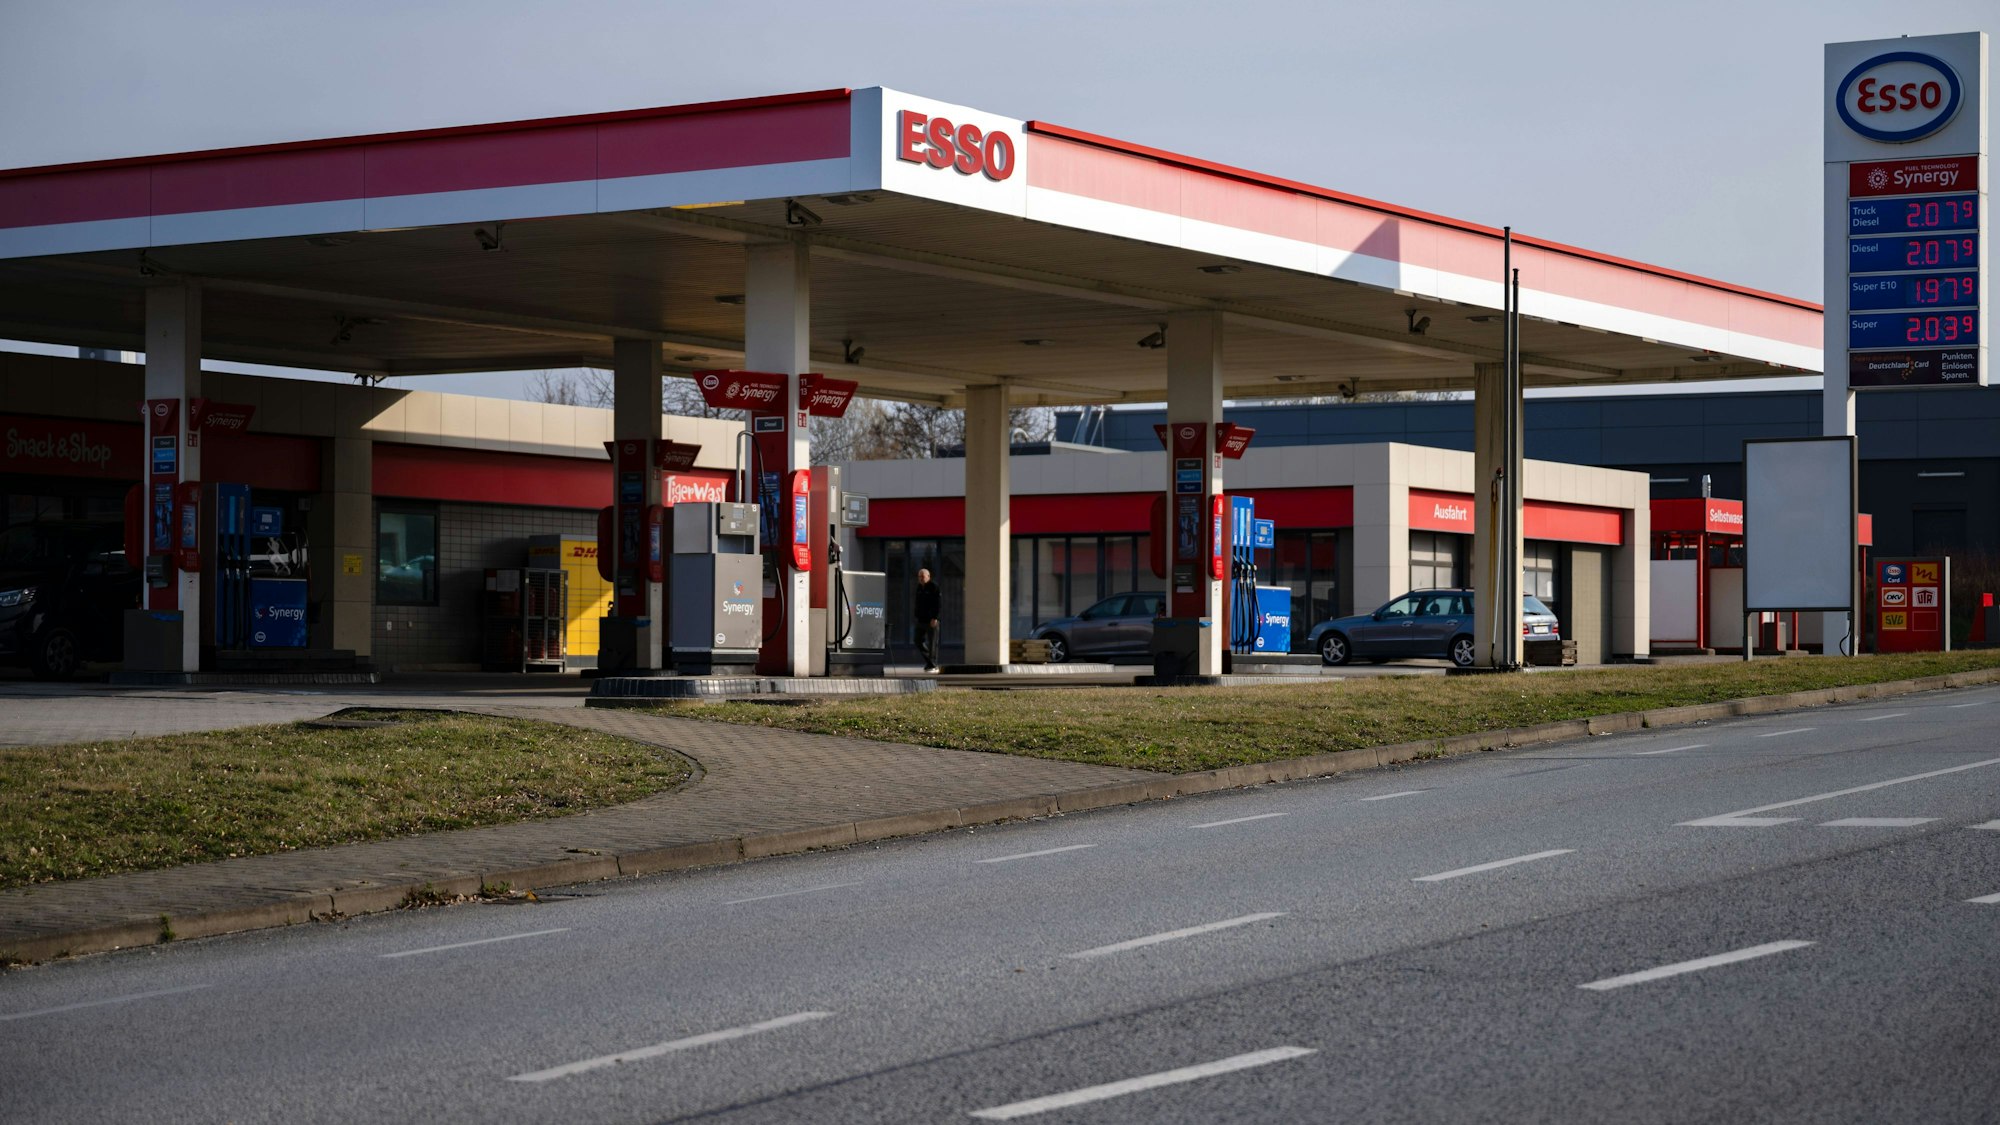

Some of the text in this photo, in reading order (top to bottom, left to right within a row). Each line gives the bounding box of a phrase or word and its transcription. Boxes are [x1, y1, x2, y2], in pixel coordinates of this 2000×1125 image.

[896, 110, 1015, 182] ESSO
[1893, 169, 1959, 188] Synergy
[1853, 206, 1876, 215] Truck
[1853, 217, 1879, 226] Diesel
[1852, 244, 1879, 253] Diesel
[1852, 283, 1878, 293] Super
[1880, 281, 1897, 290] E10
[1852, 321, 1878, 331] Super
[1941, 353, 1975, 361] Punkten.
[1941, 362, 1975, 370] Einlösen.
[1941, 371, 1970, 380] Sparen.
[740, 385, 778, 402] Synergy
[205, 414, 245, 429] Synergy
[1434, 504, 1467, 520] Ausfahrt
[573, 547, 598, 558] DH
[268, 606, 305, 620] Synergy
[722, 601, 754, 615] Synergy
[856, 604, 884, 618] Synergy
[1266, 613, 1290, 627] Synergy
[1885, 615, 1904, 625] SVG
